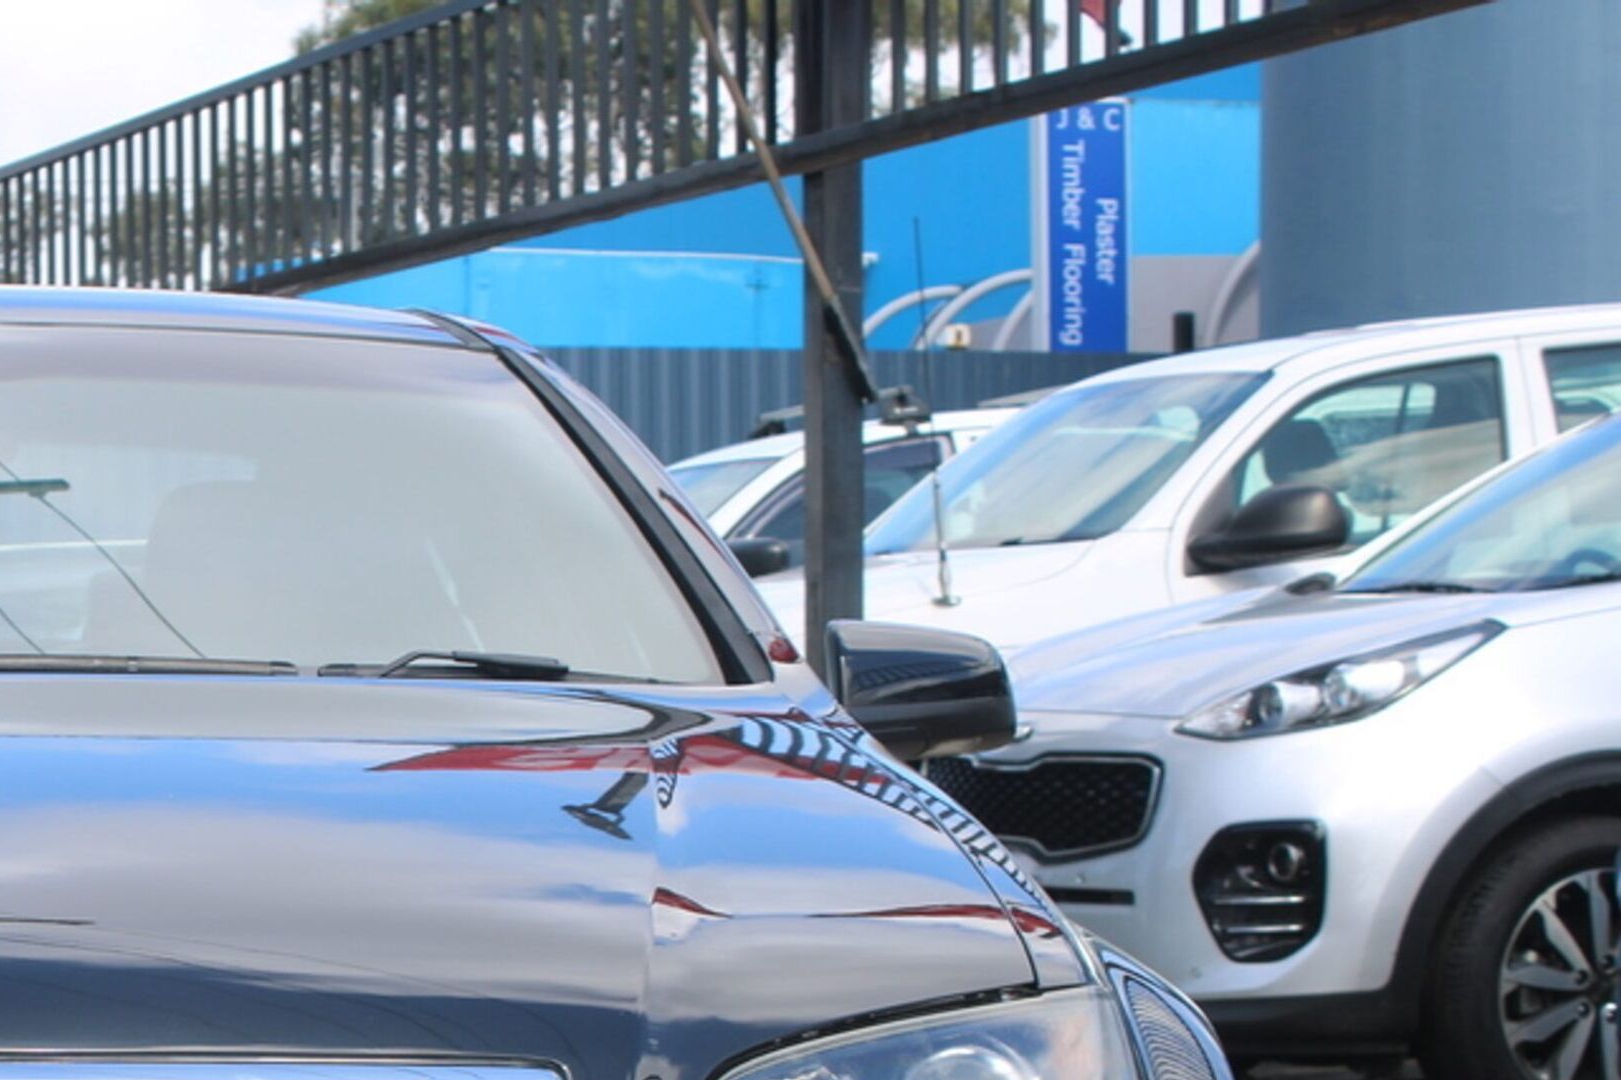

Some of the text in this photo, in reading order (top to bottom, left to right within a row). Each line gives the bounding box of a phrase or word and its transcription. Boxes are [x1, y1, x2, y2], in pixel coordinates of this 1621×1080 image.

[1056, 106, 1121, 131] J & C
[1058, 138, 1087, 346] Timber Flooring
[1095, 197, 1119, 286] Plaster
